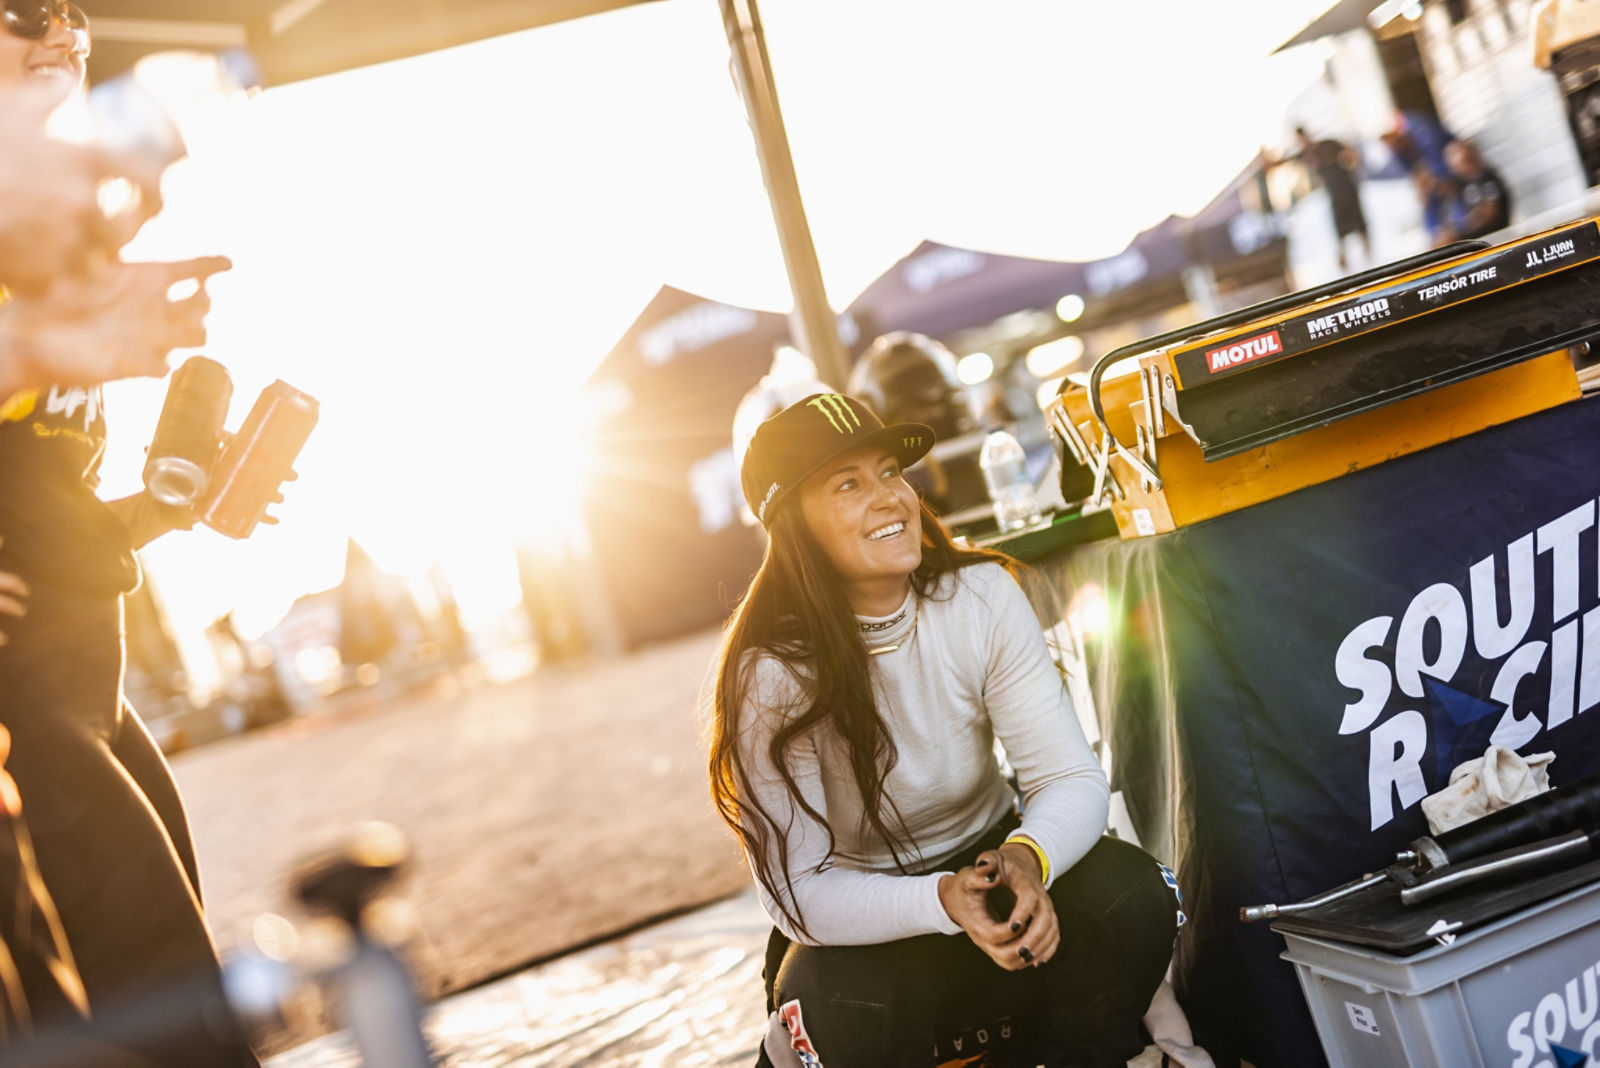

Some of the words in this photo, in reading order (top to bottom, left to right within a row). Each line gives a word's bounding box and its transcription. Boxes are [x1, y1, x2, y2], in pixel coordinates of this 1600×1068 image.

[1418, 276, 1467, 301] TENSOR
[1469, 266, 1496, 285] TIRE
[1306, 298, 1389, 333] METHOD
[1310, 326, 1339, 340] RACE
[1344, 309, 1391, 329] WHEELS
[1212, 334, 1278, 369] MOTUL
[1335, 495, 1600, 735] SOUT
[1507, 960, 1600, 1068] SOU
